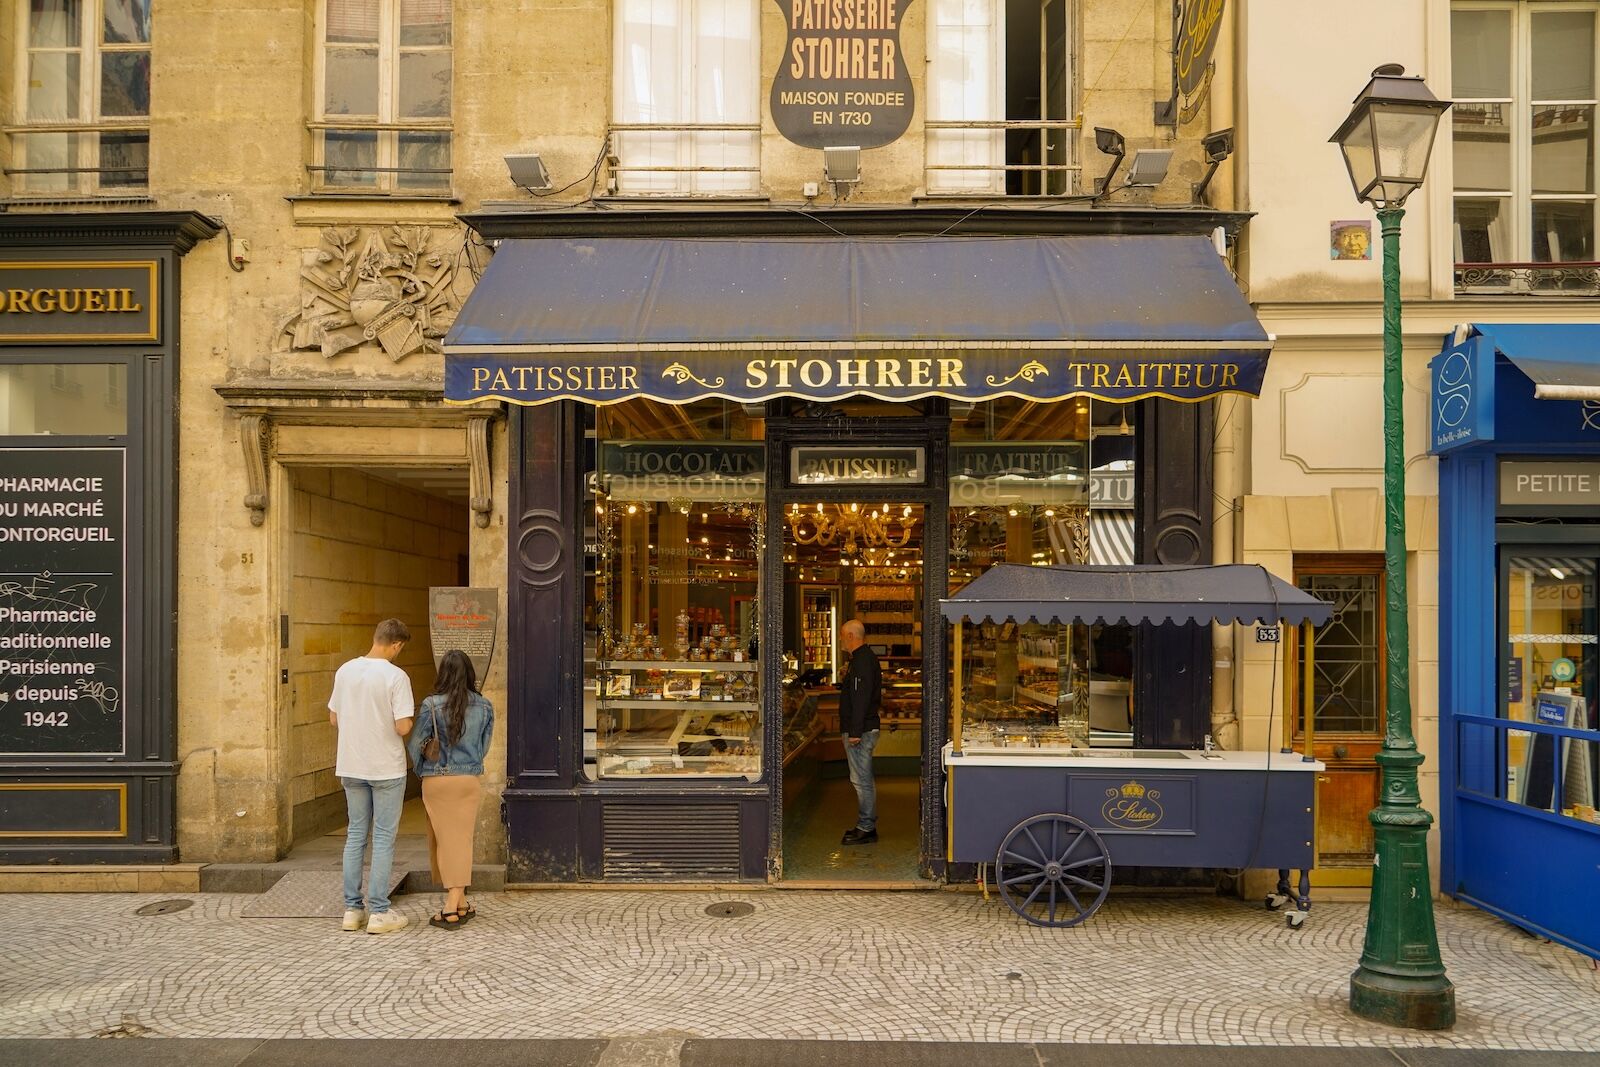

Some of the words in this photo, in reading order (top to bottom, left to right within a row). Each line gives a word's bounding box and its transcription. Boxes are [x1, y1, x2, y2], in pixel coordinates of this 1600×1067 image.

[791, 37, 896, 80] STOHRER
[781, 91, 839, 105] MAISON
[813, 111, 833, 125] EN
[839, 111, 872, 126] 1730
[0, 288, 142, 313] RGUEIL
[472, 366, 640, 391] PATISSIER
[745, 358, 967, 389] STOHRER
[1068, 362, 1240, 388] TRAITEUR
[1517, 474, 1590, 492] PETITE
[23, 498, 104, 517] MARCHÉ
[241, 553, 254, 564] 51
[0, 607, 97, 622] Pharmacie
[0, 633, 111, 648] aditionnelle
[1260, 629, 1277, 641] 53
[0, 659, 95, 675] Parisienne
[15, 685, 78, 703] depuis
[24, 711, 69, 727] 1942
[1108, 800, 1157, 821] Stohrer
